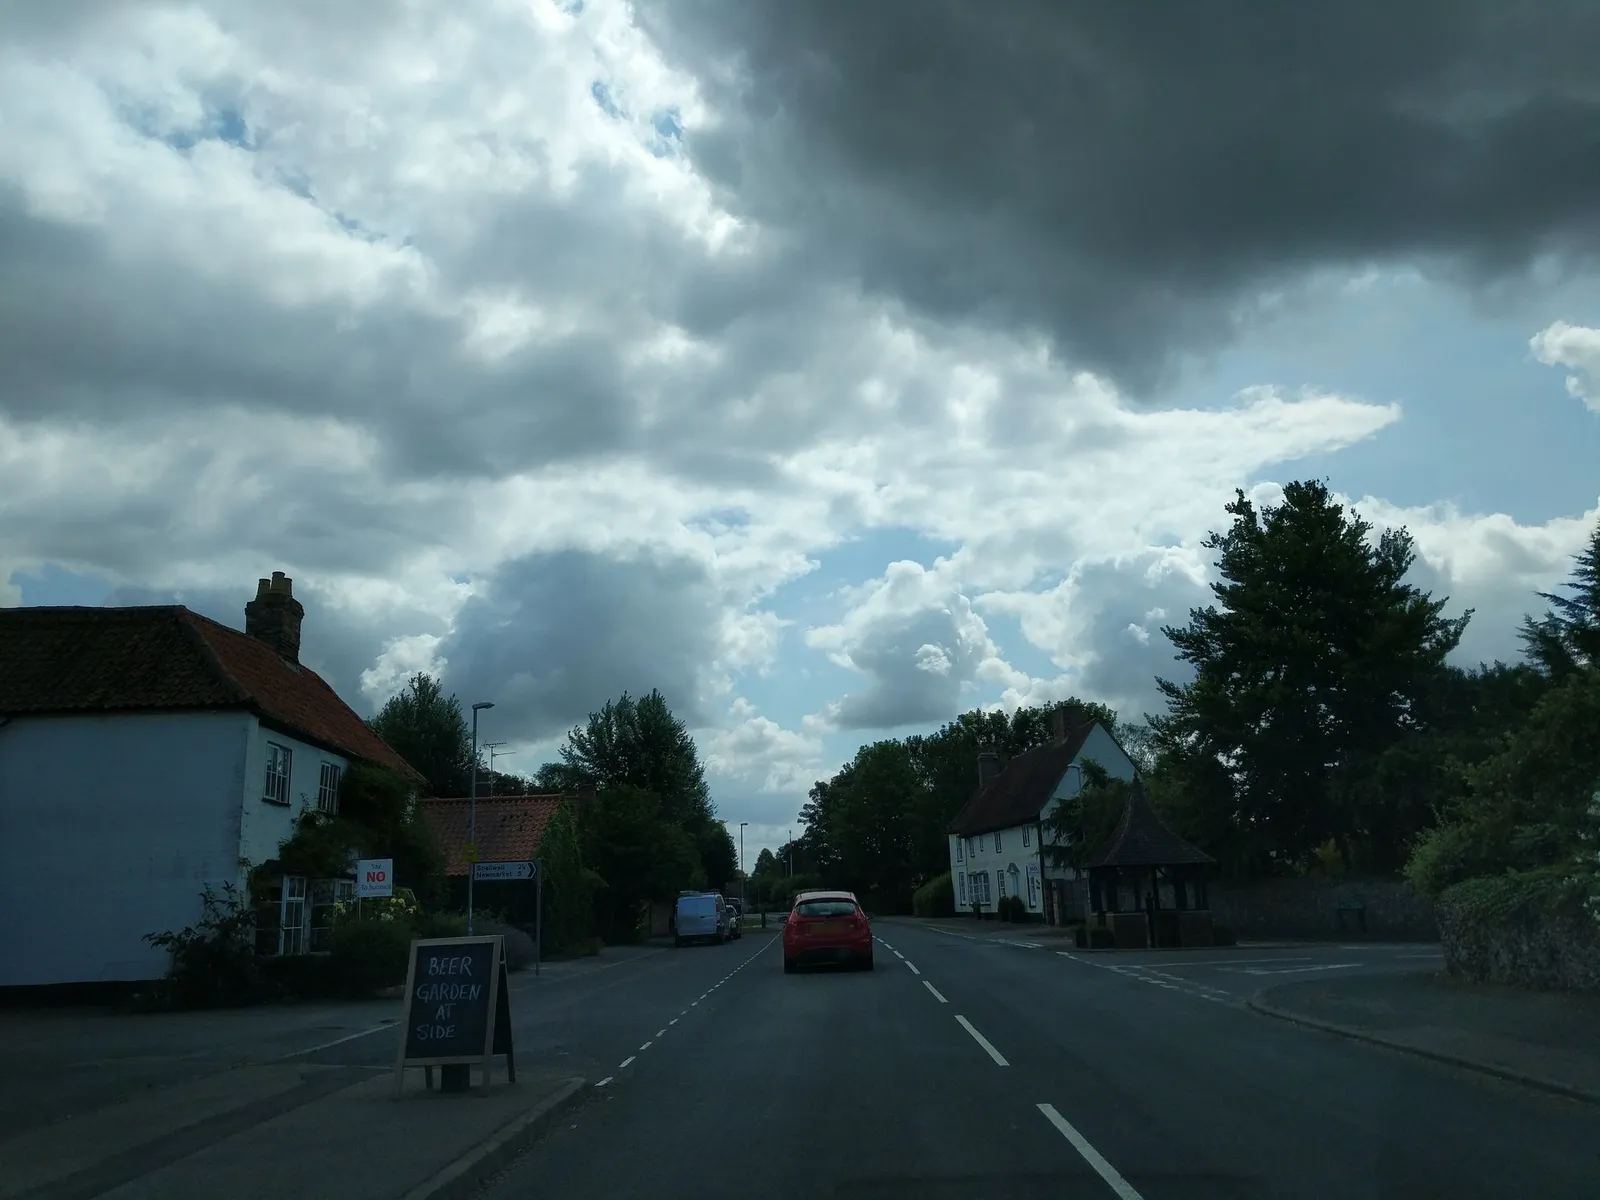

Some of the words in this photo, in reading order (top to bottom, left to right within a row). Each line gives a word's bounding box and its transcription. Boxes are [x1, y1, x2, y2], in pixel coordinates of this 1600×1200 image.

[366, 871, 386, 882] NO
[476, 870, 513, 878] Newmarket
[428, 956, 473, 976] BEER
[416, 982, 482, 1003] GARDEN
[435, 1003, 457, 1020] AT
[416, 1024, 457, 1041] SIDE
